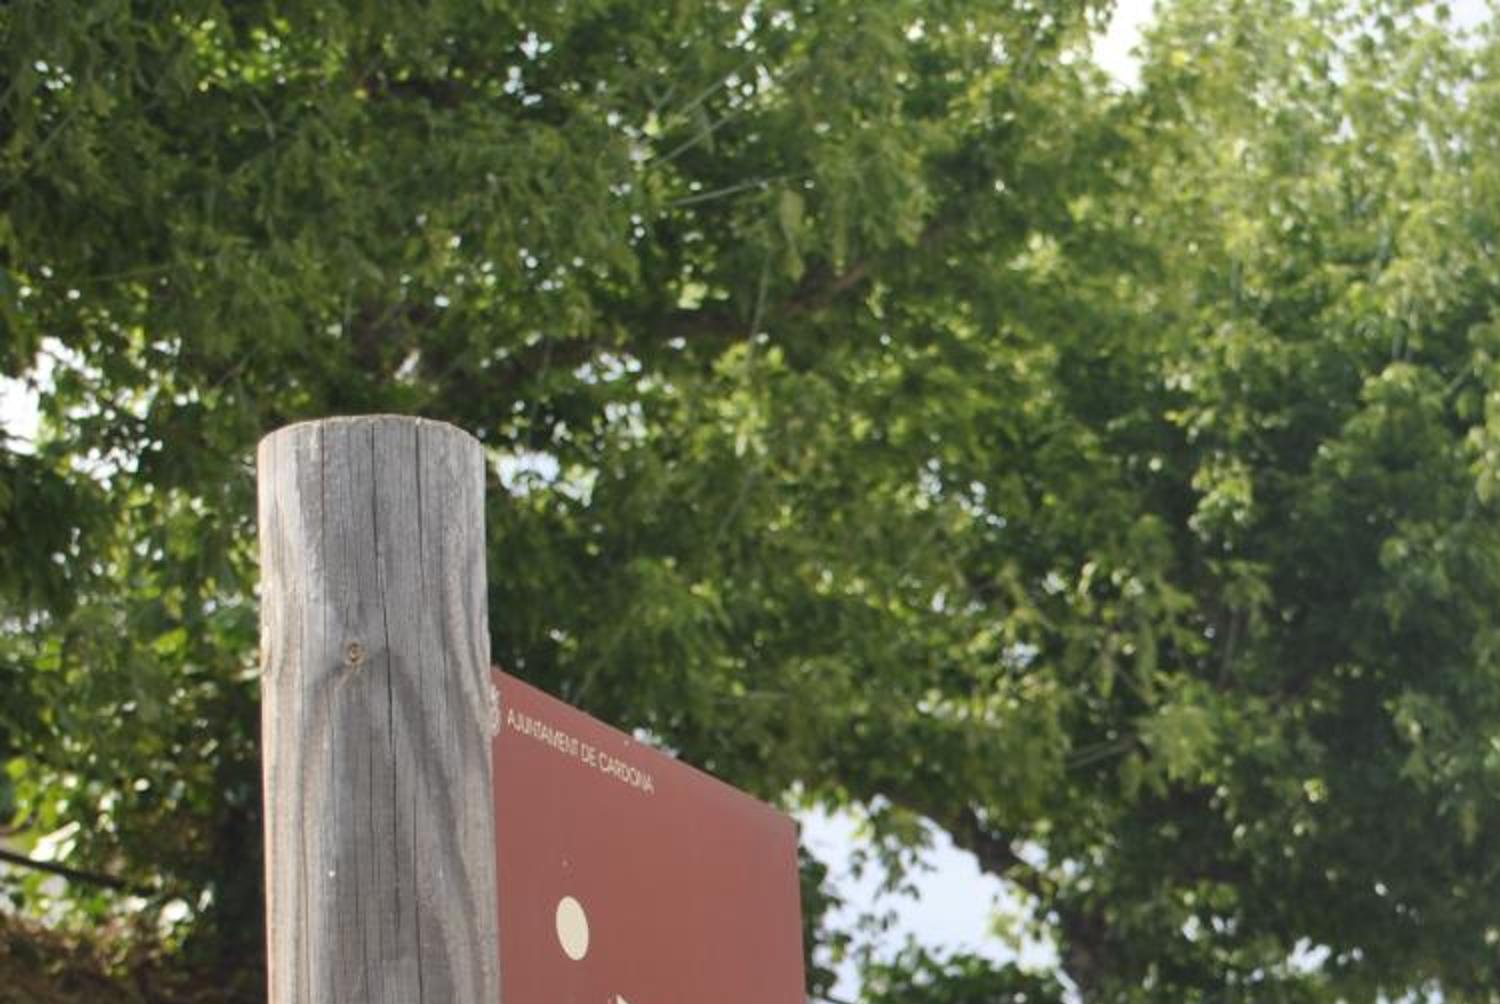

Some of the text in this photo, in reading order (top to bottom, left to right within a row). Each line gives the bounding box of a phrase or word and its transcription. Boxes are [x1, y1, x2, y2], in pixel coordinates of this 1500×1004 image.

[507, 708, 654, 794] AJUNTAMENT DE CARDONA
